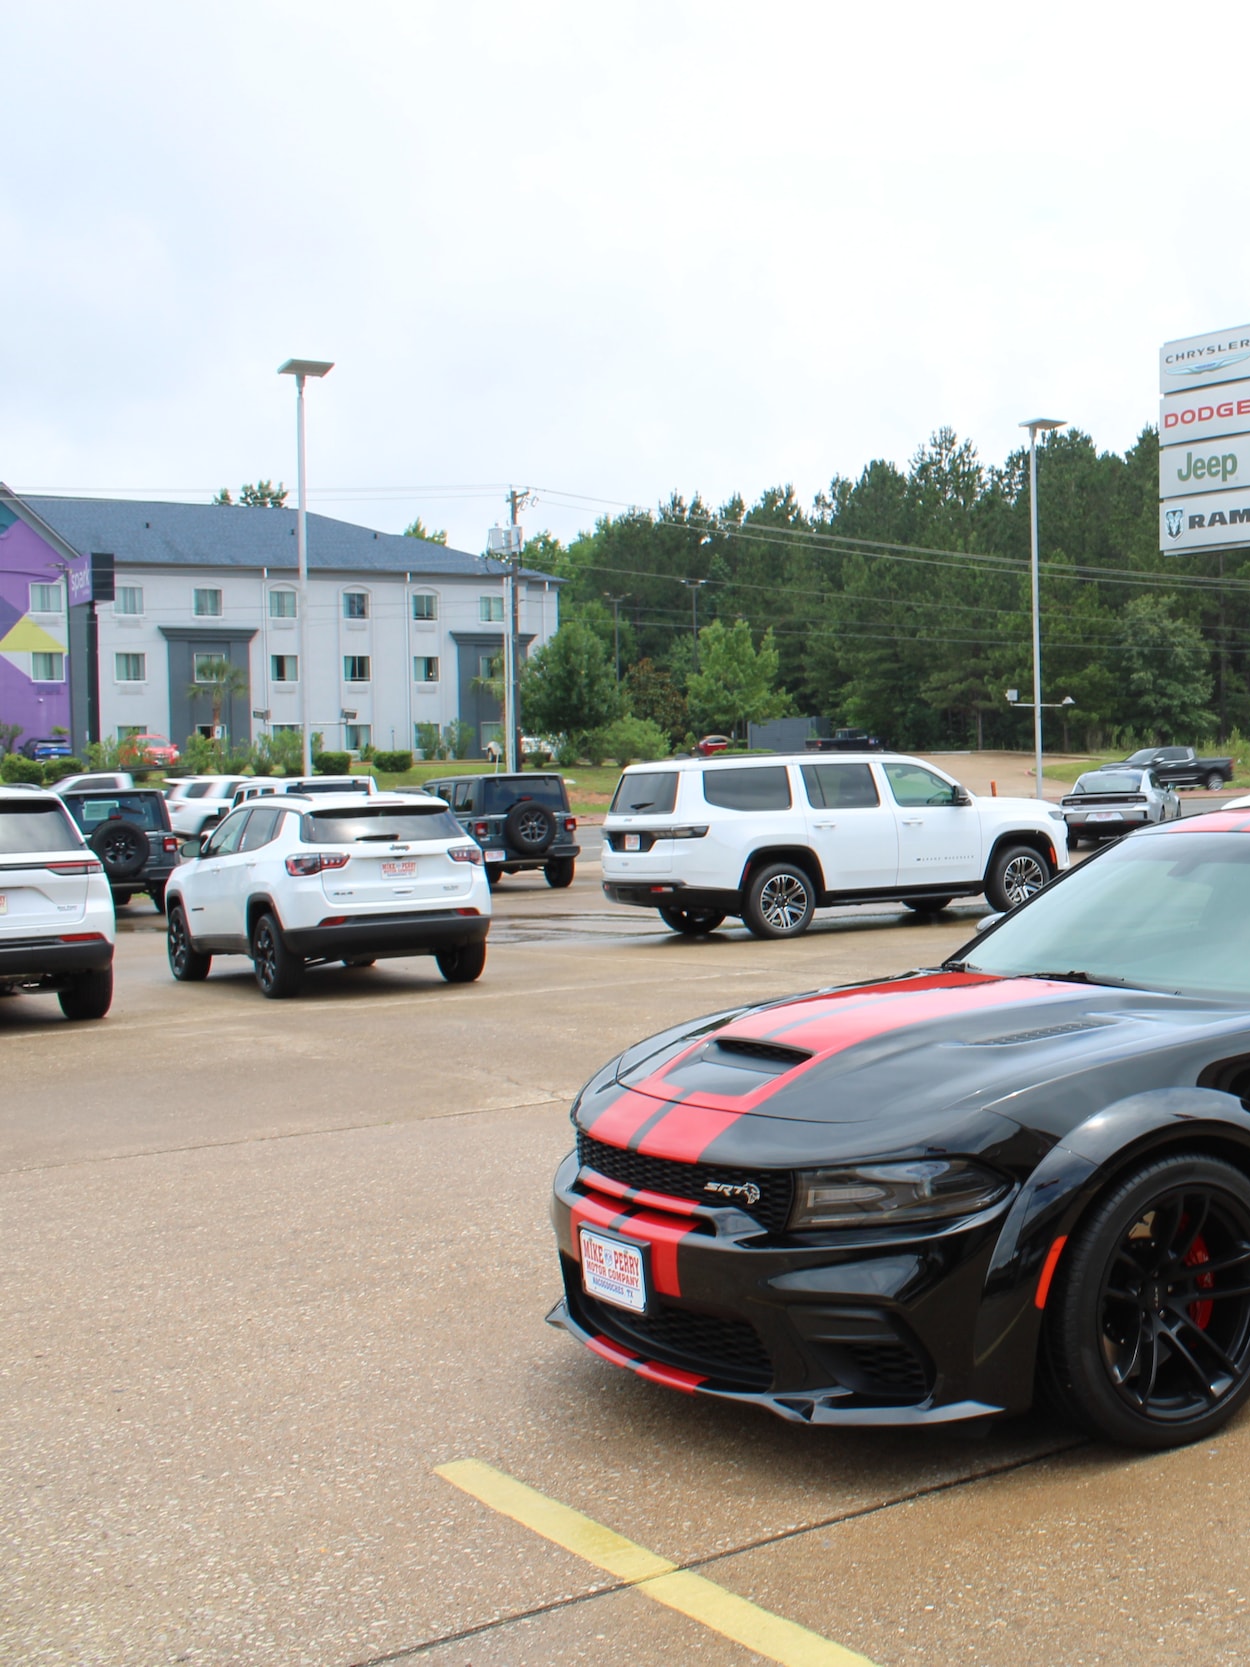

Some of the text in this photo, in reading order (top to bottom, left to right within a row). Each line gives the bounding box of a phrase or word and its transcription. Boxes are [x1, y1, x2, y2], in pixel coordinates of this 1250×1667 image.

[1165, 339, 1250, 364] CHRYSLER
[1177, 451, 1238, 482] Jeep
[72, 560, 89, 598] spark
[703, 1182, 745, 1197] SRT
[583, 1239, 640, 1277] MIKE PERRY
[586, 1260, 640, 1288] MOTOR COMPANY
